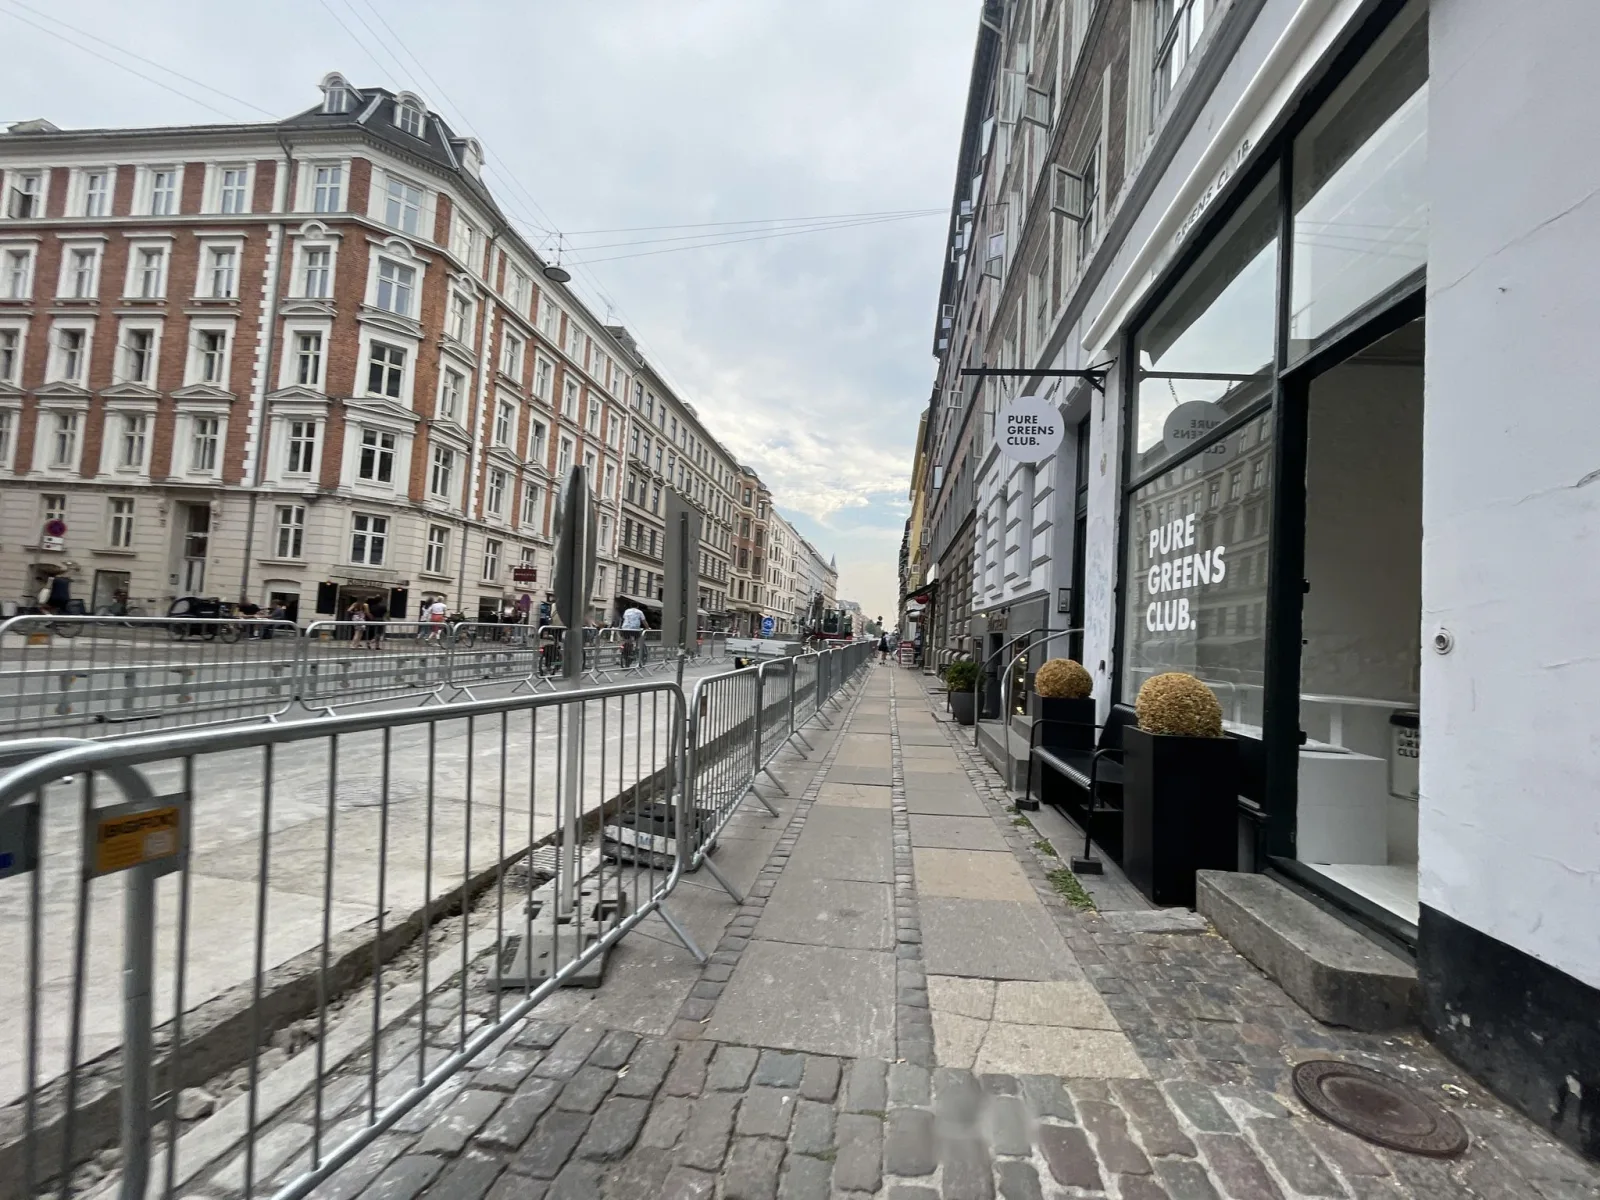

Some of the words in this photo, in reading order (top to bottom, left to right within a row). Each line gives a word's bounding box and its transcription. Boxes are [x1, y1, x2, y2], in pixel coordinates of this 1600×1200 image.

[1007, 415, 1039, 424] PURE
[1007, 426, 1055, 435] GREENS
[1006, 437, 1040, 446] CLUB.
[1149, 513, 1196, 559] PURE
[1147, 546, 1226, 595] GREENS
[1146, 598, 1197, 632] CLUB.
